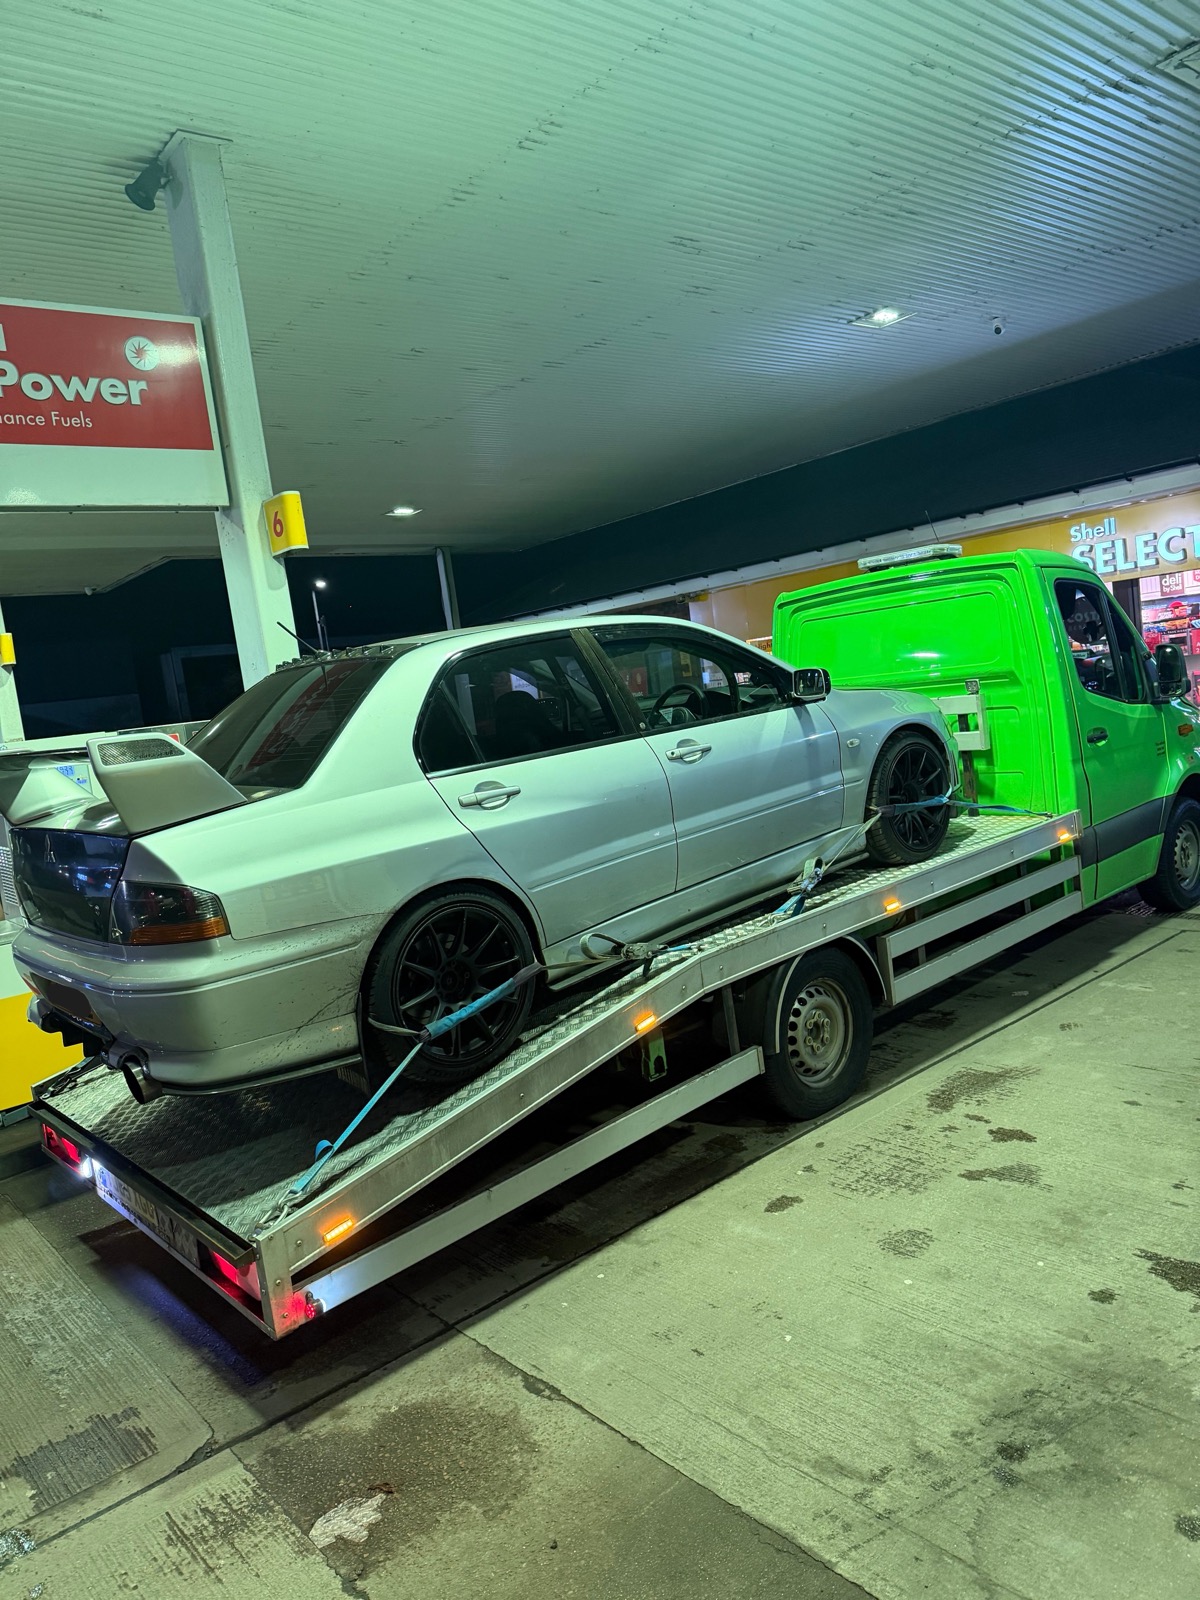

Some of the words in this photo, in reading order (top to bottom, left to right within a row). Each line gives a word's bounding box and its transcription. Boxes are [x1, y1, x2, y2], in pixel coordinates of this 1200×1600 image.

[0, 412, 46, 426] ance
[51, 410, 93, 428] Fuels
[273, 510, 284, 538] 6
[1070, 517, 1117, 542] Shell
[1161, 573, 1182, 587] deli
